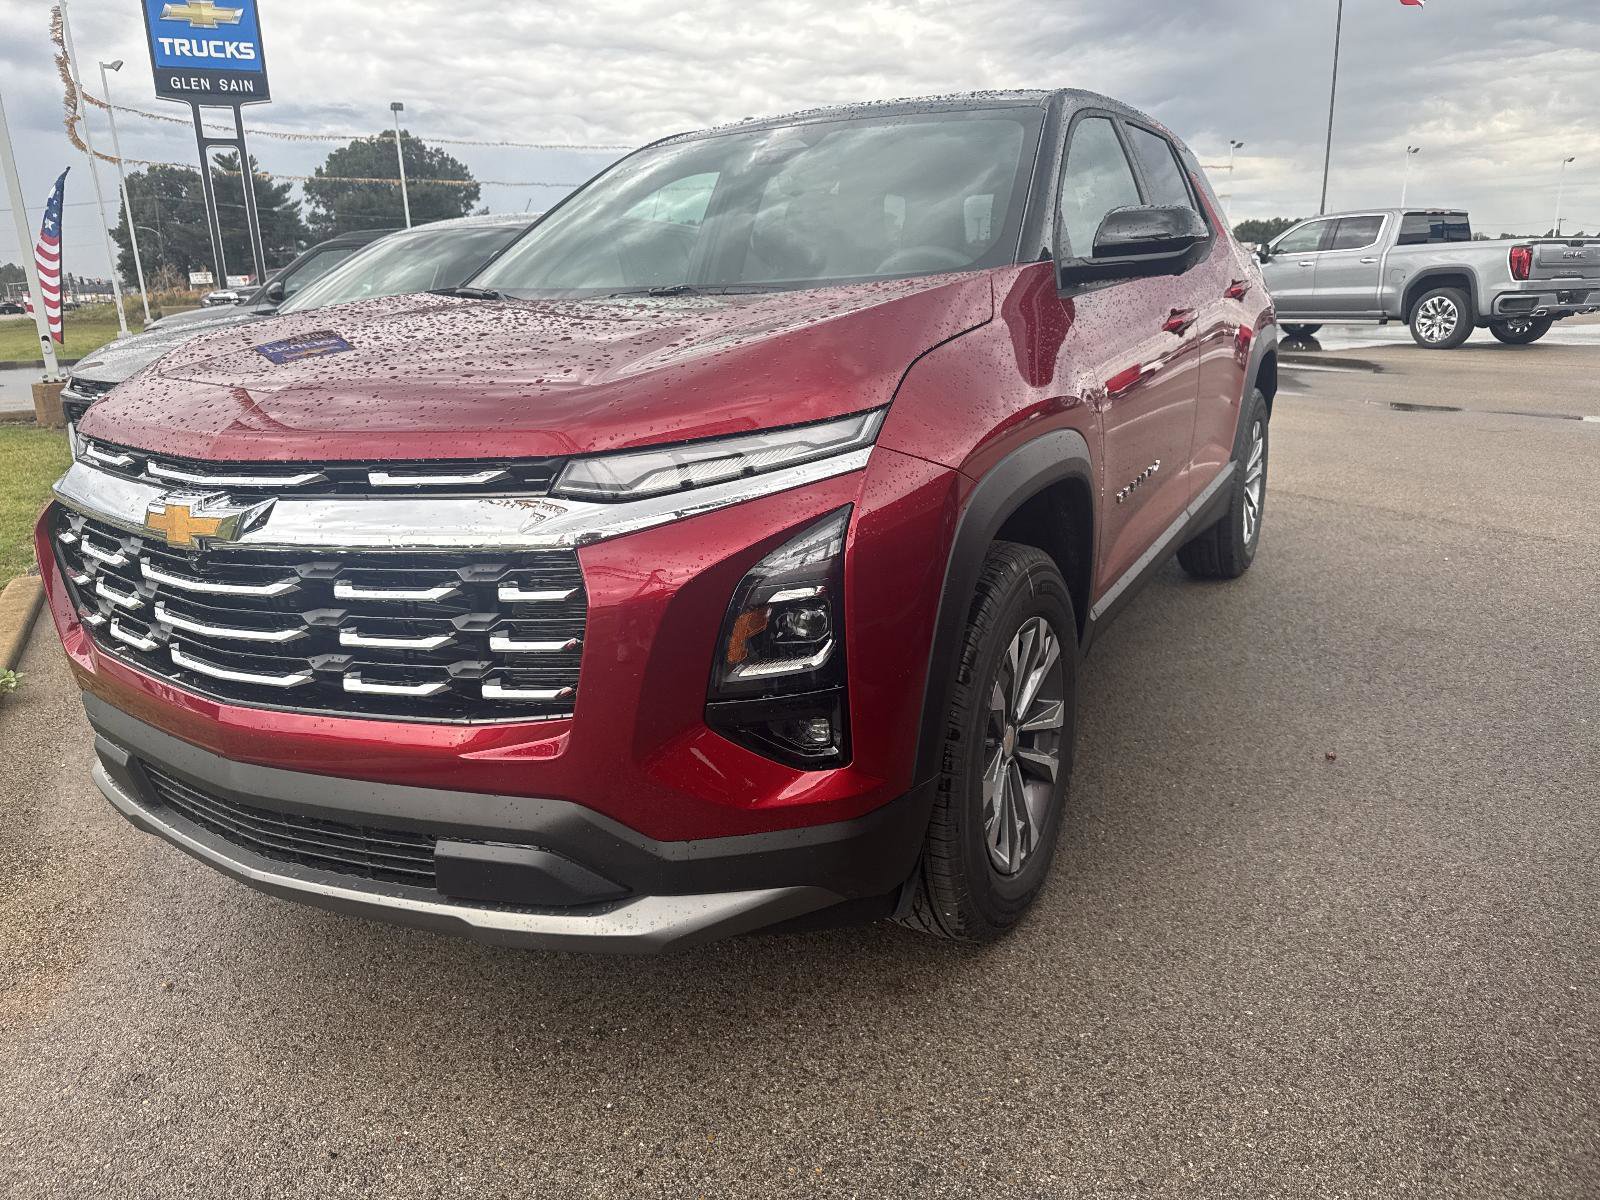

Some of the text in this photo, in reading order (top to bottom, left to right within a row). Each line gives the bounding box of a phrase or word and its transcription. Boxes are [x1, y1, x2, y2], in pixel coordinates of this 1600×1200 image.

[158, 37, 256, 60] TRUCKS
[170, 76, 254, 92] GLEN SAIN
